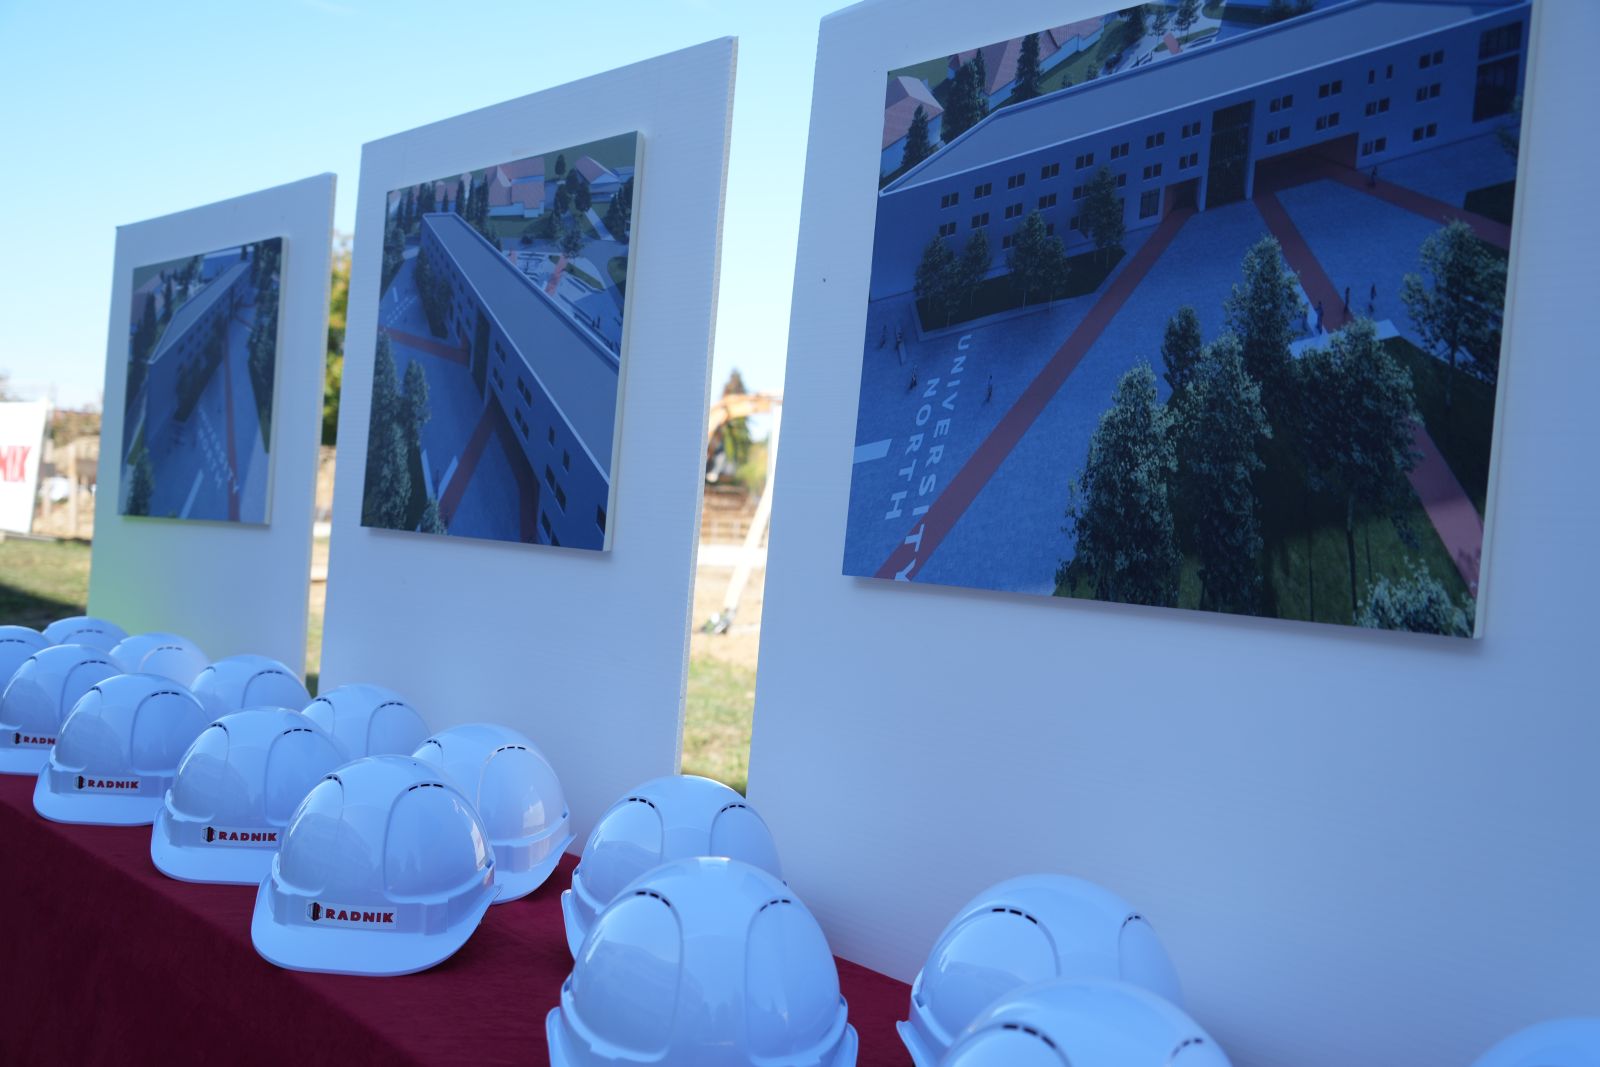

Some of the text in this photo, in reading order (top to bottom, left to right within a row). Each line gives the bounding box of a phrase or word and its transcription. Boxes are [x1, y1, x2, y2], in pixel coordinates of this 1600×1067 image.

[884, 377, 941, 521] NORTH
[894, 333, 972, 582] UNIVERSITY
[23, 735, 56, 745] RADN
[87, 779, 140, 790] RADNIK
[218, 831, 278, 843] RADNIK
[325, 908, 394, 923] RADNIK
